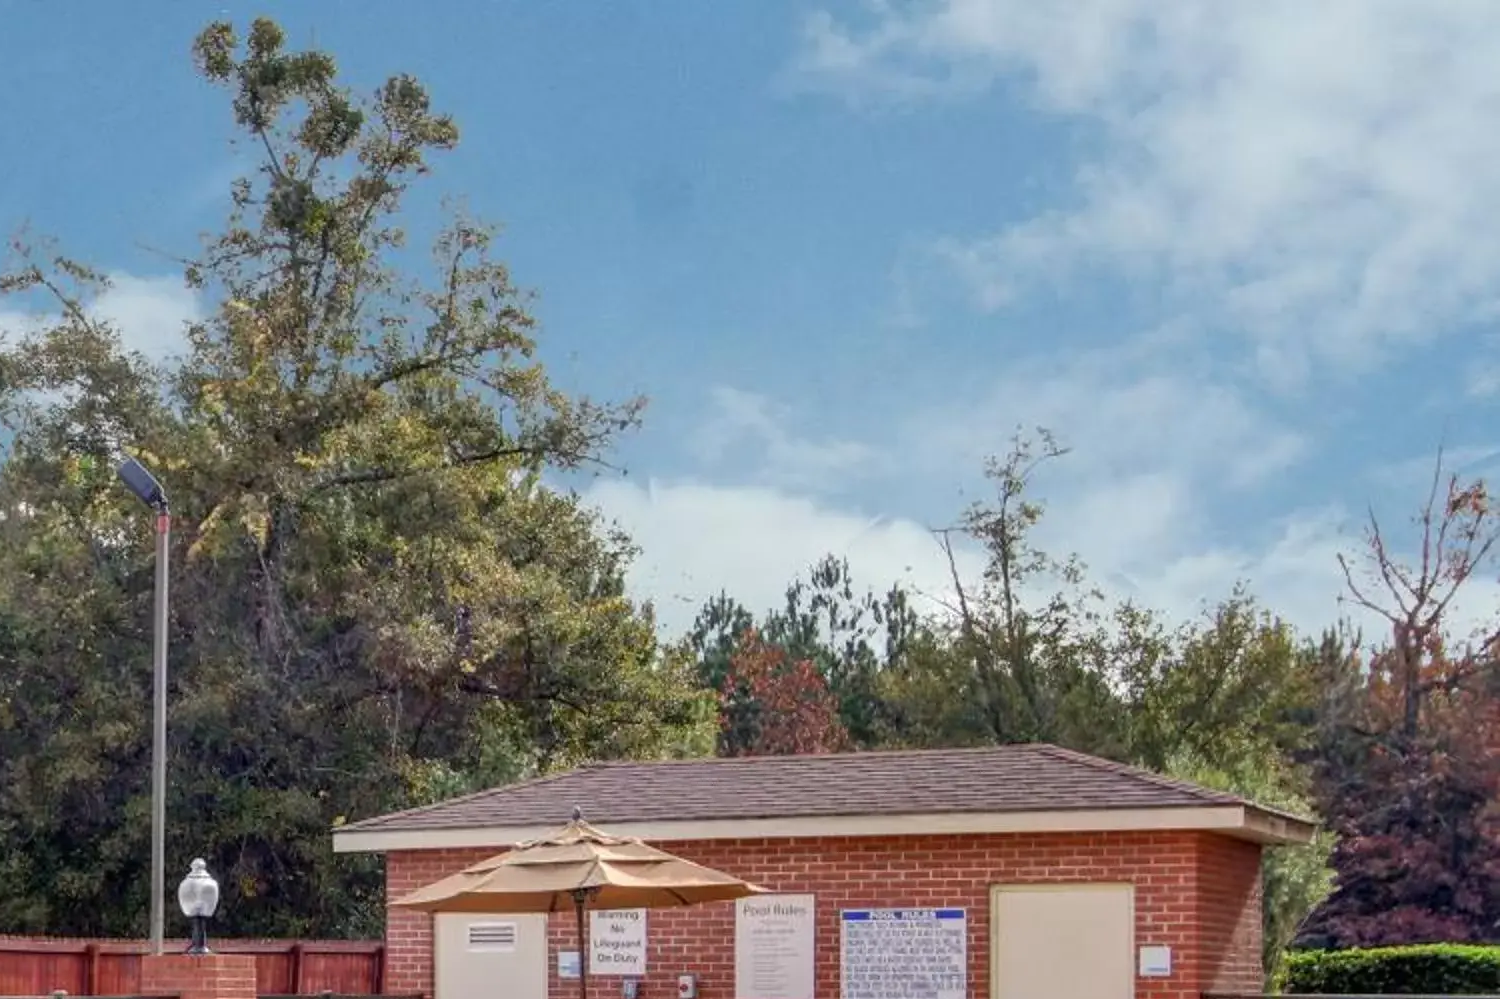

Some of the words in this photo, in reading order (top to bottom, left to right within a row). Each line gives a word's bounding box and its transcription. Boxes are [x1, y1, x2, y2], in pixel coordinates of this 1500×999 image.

[743, 904, 770, 917] Pool
[773, 904, 808, 915] Rules
[611, 924, 625, 933] No
[593, 939, 641, 949] Lifeguard
[597, 953, 612, 962] On
[614, 953, 638, 963] Duty
